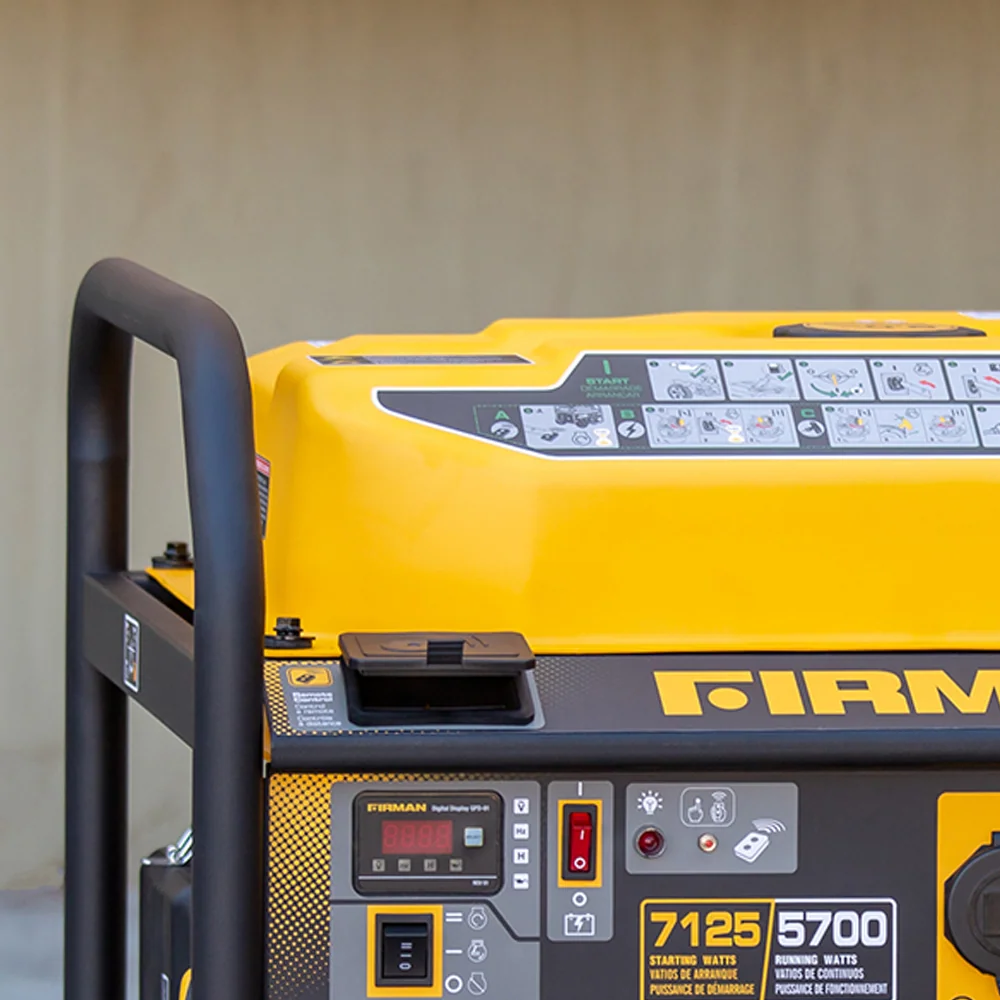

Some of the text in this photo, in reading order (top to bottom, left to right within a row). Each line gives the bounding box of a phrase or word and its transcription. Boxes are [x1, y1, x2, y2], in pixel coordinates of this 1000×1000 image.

[367, 803, 427, 813] FIRMAN
[650, 911, 761, 948] 7125
[777, 910, 888, 948] 5700
[650, 955, 737, 966] STARTING WATTS
[775, 954, 858, 966] RUNNING WATTS
[650, 968, 738, 980] VATIOS DE ARRANQUE
[774, 968, 865, 980] VATIOS DE CONTINUOS
